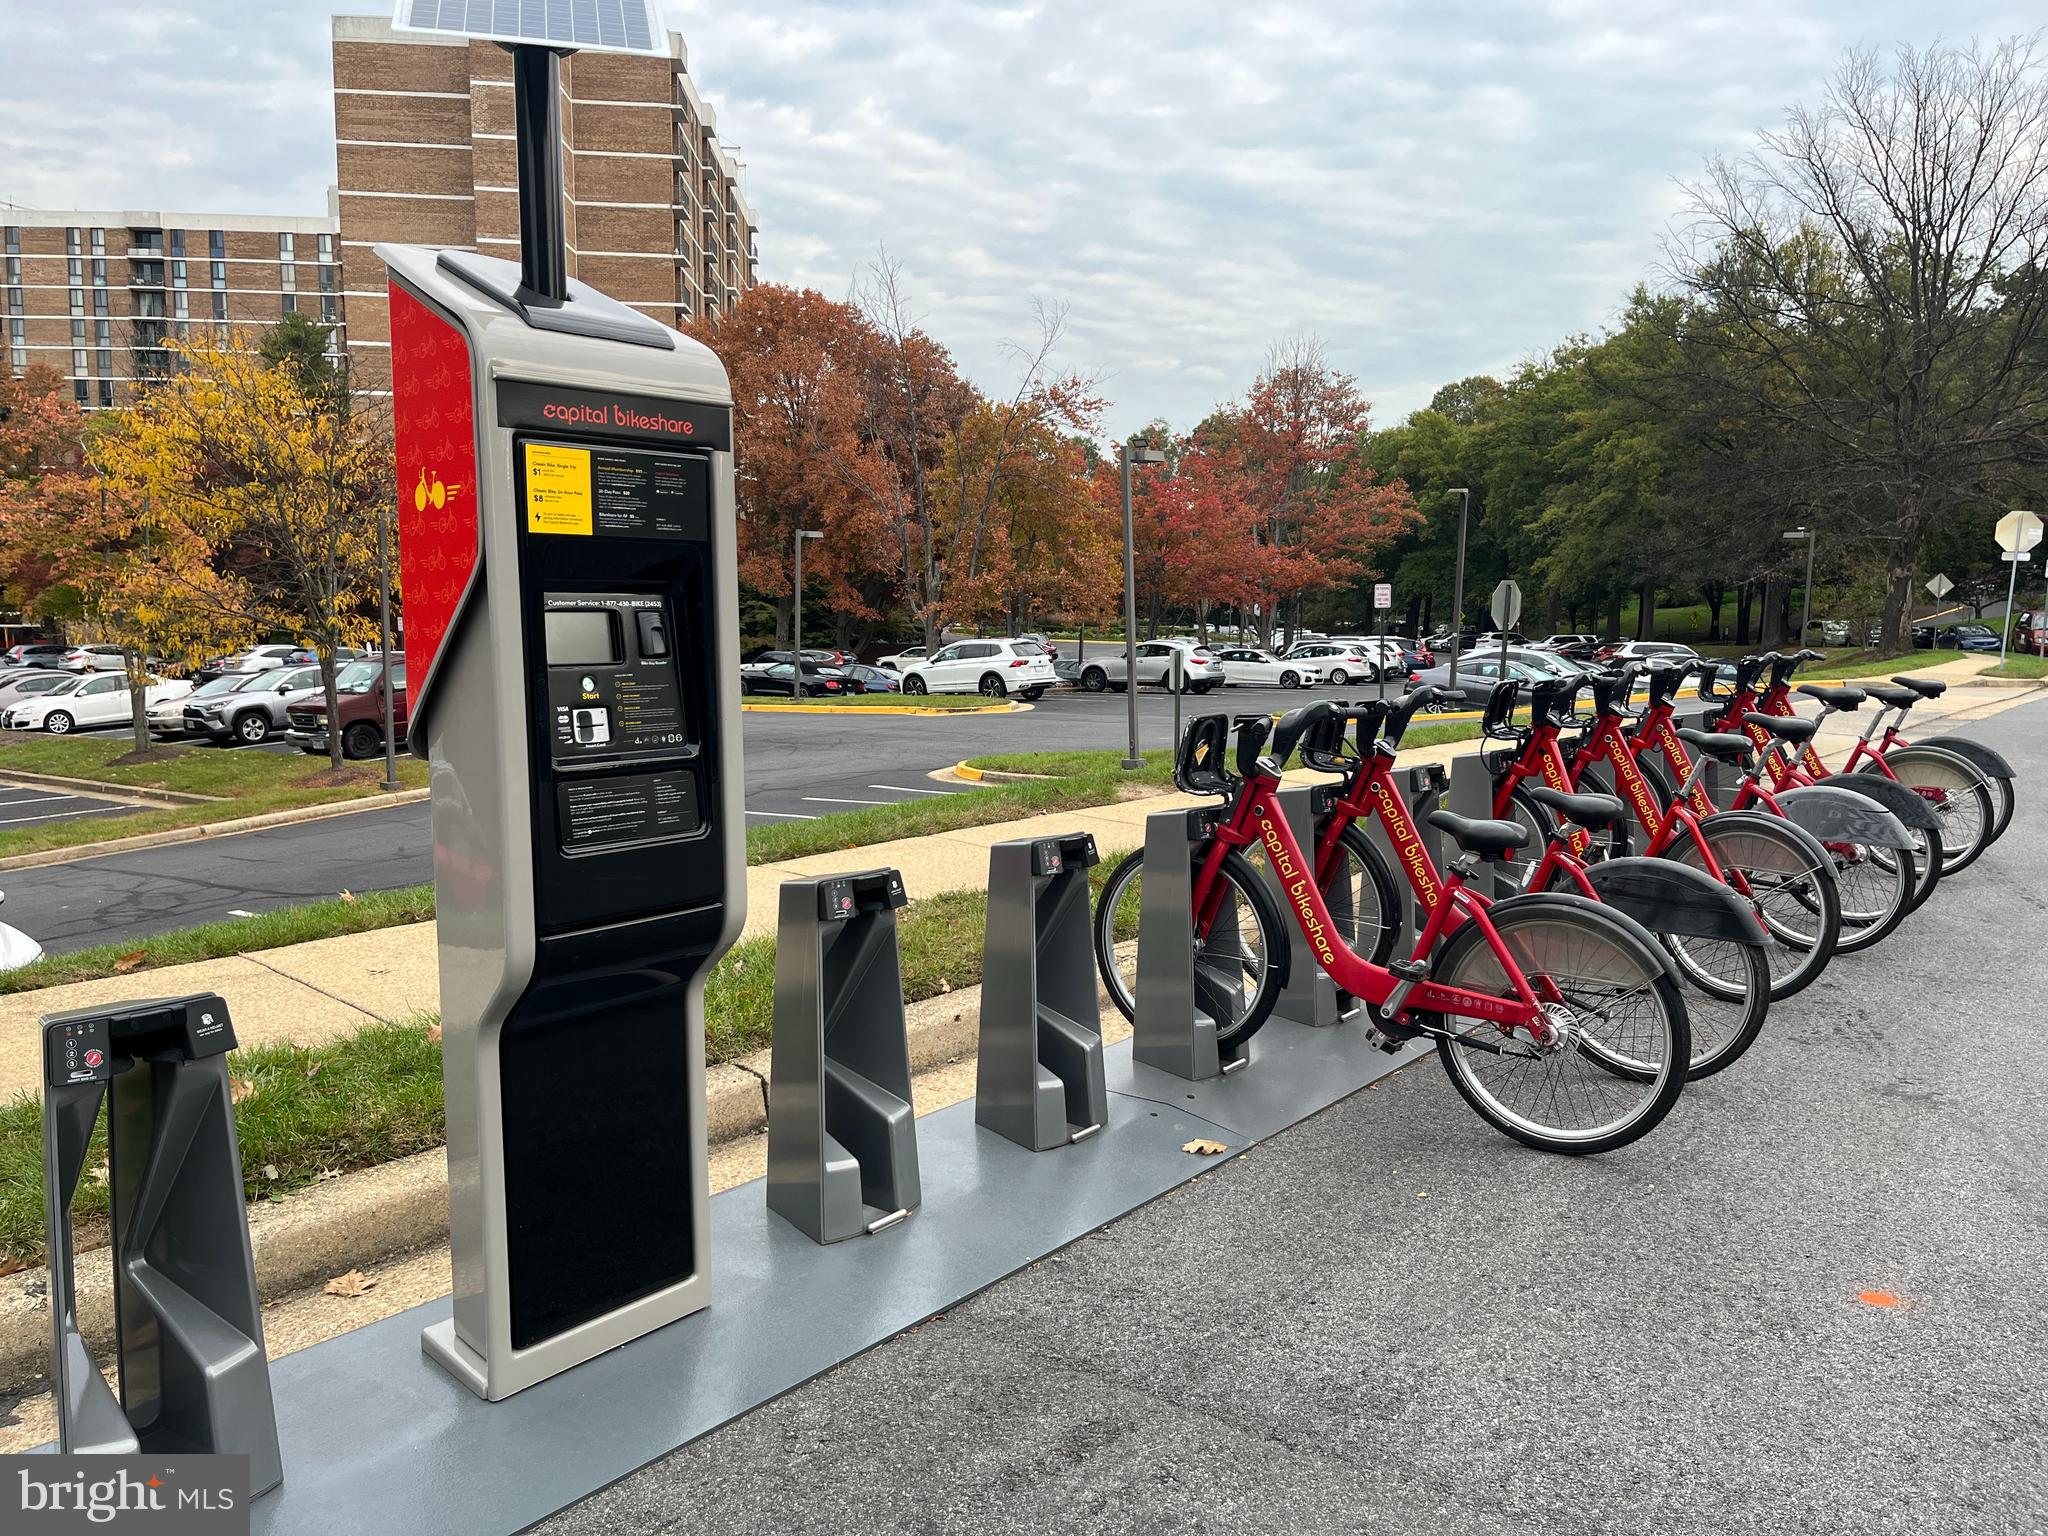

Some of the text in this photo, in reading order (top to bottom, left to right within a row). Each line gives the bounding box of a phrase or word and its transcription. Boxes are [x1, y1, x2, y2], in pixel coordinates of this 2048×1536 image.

[543, 403, 694, 435] capital bikeshare
[532, 468, 541, 476] $1
[533, 494, 544, 502] $8
[547, 599, 577, 607] Customer
[577, 599, 600, 607] Service:
[644, 600, 662, 609] (2453)
[582, 692, 600, 700] Start
[1747, 722, 1768, 744] pital
[1610, 740, 1637, 781] capital
[1660, 728, 1686, 766] capital
[1378, 789, 1413, 842] capital
[1260, 819, 1335, 965] capital bikeshare
